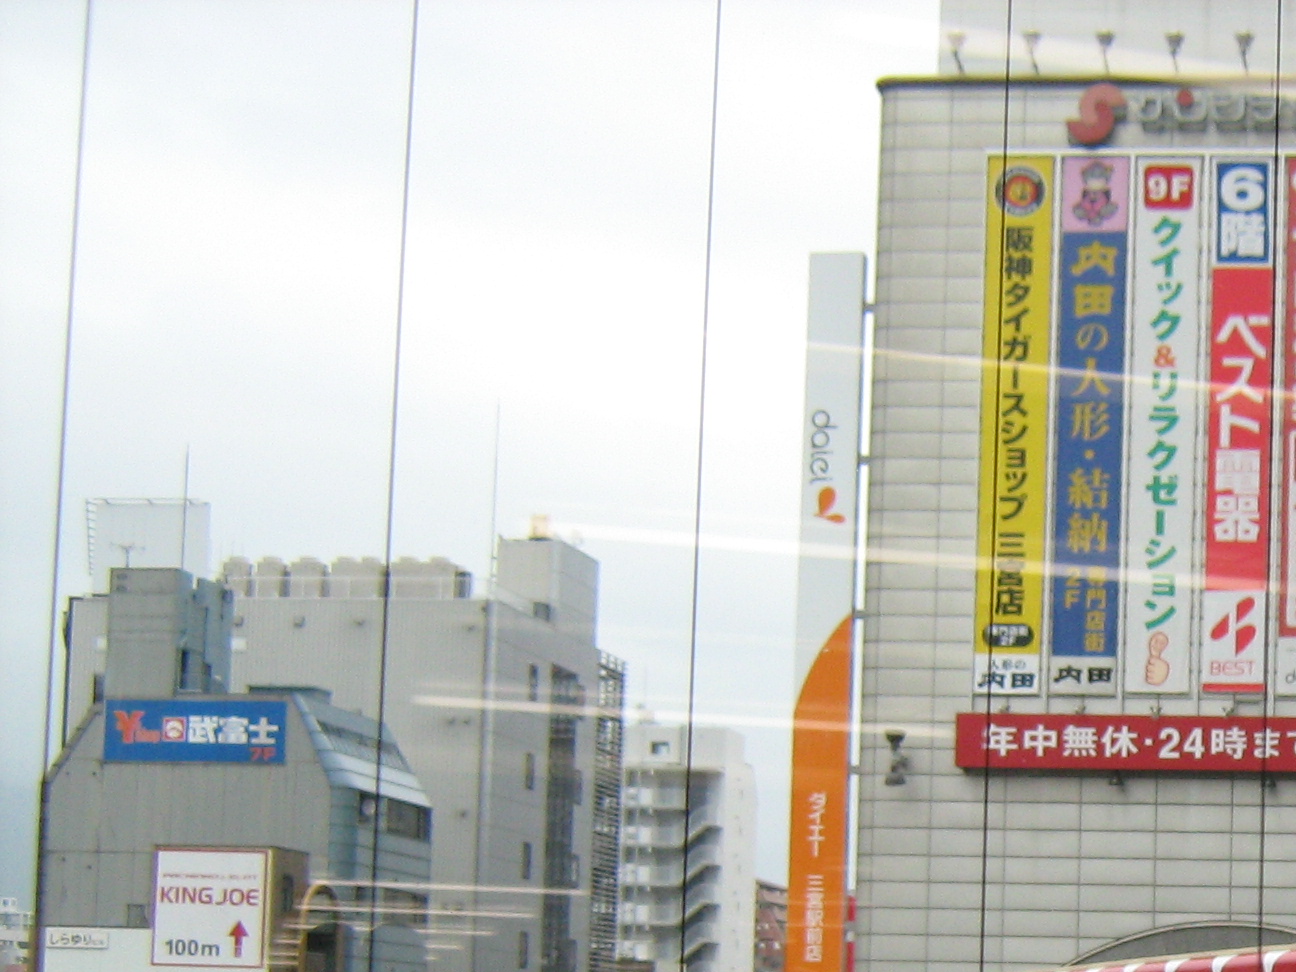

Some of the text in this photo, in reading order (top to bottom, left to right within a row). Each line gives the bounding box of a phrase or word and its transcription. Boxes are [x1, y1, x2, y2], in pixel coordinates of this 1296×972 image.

[1147, 172, 1190, 202] 9F
[1219, 166, 1267, 259] 6階
[1212, 314, 1271, 543] ベスト電器
[1209, 660, 1255, 676] BEST
[188, 715, 279, 745] 武富士
[807, 792, 827, 858] ダイエー
[159, 886, 260, 907] KING JOE
